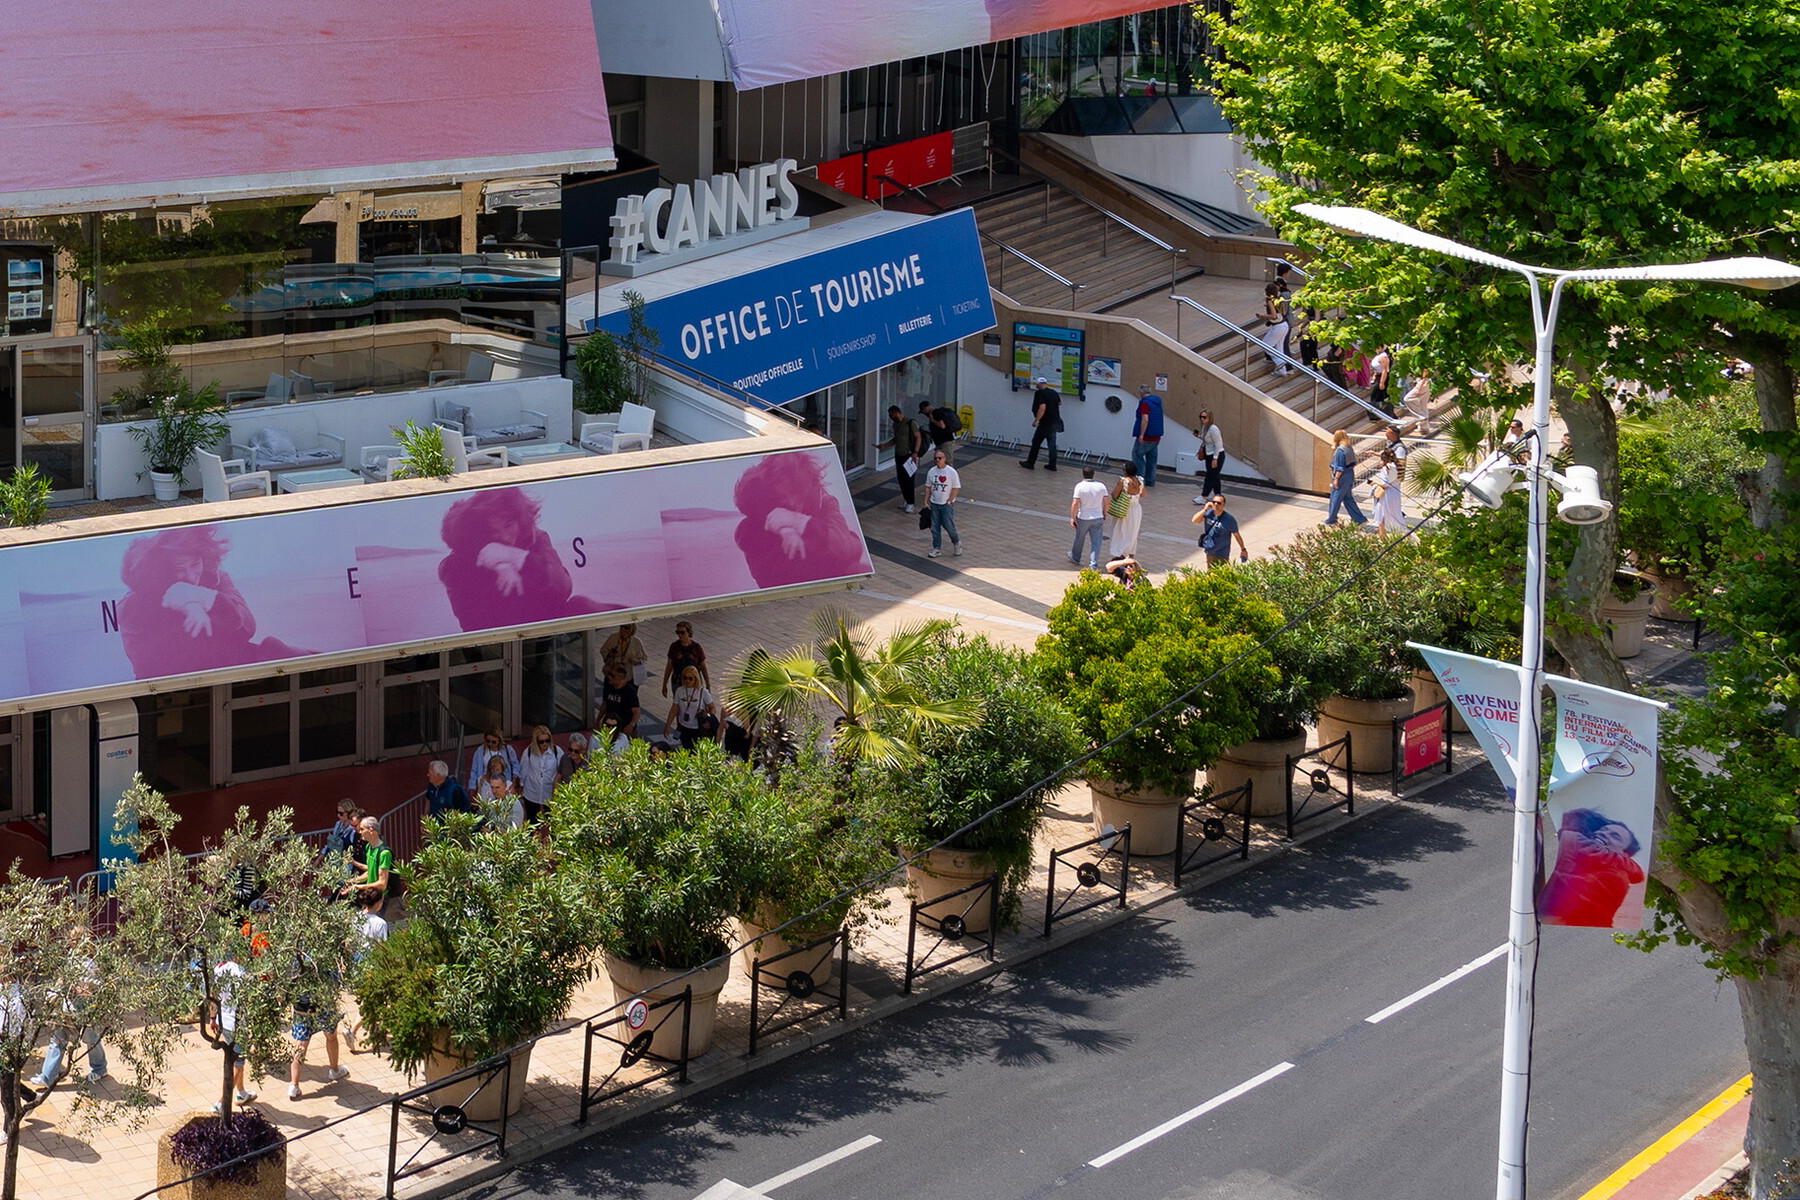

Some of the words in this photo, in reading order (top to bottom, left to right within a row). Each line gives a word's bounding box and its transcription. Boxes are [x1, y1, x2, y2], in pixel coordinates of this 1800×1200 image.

[609, 158, 799, 264] #CANNES
[681, 300, 771, 360] OFFICE
[775, 289, 808, 330] DE
[810, 253, 925, 318] TOURISME
[952, 298, 980, 316] TICKETING
[898, 314, 933, 335] BILLETTERIE
[826, 339, 860, 360] SOUVENIRS
[860, 333, 877, 351] SHOP
[733, 370, 768, 391] BOUTIQUE
[768, 358, 804, 384] OFFICIELLE
[1456, 694, 1520, 711] ENVENU
[1468, 706, 1519, 723] LCOME
[1564, 709, 1577, 718] 78.
[1582, 713, 1624, 728] FESTIVAL
[1564, 716, 1633, 738] INTERNATIONAL
[1564, 724, 1578, 732] DU
[1582, 726, 1603, 737] FILM
[1607, 732, 1619, 740] DE
[1624, 735, 1652, 757] CANNES
[1600, 738, 1617, 747] MAI
[1620, 741, 1639, 754] 2025
